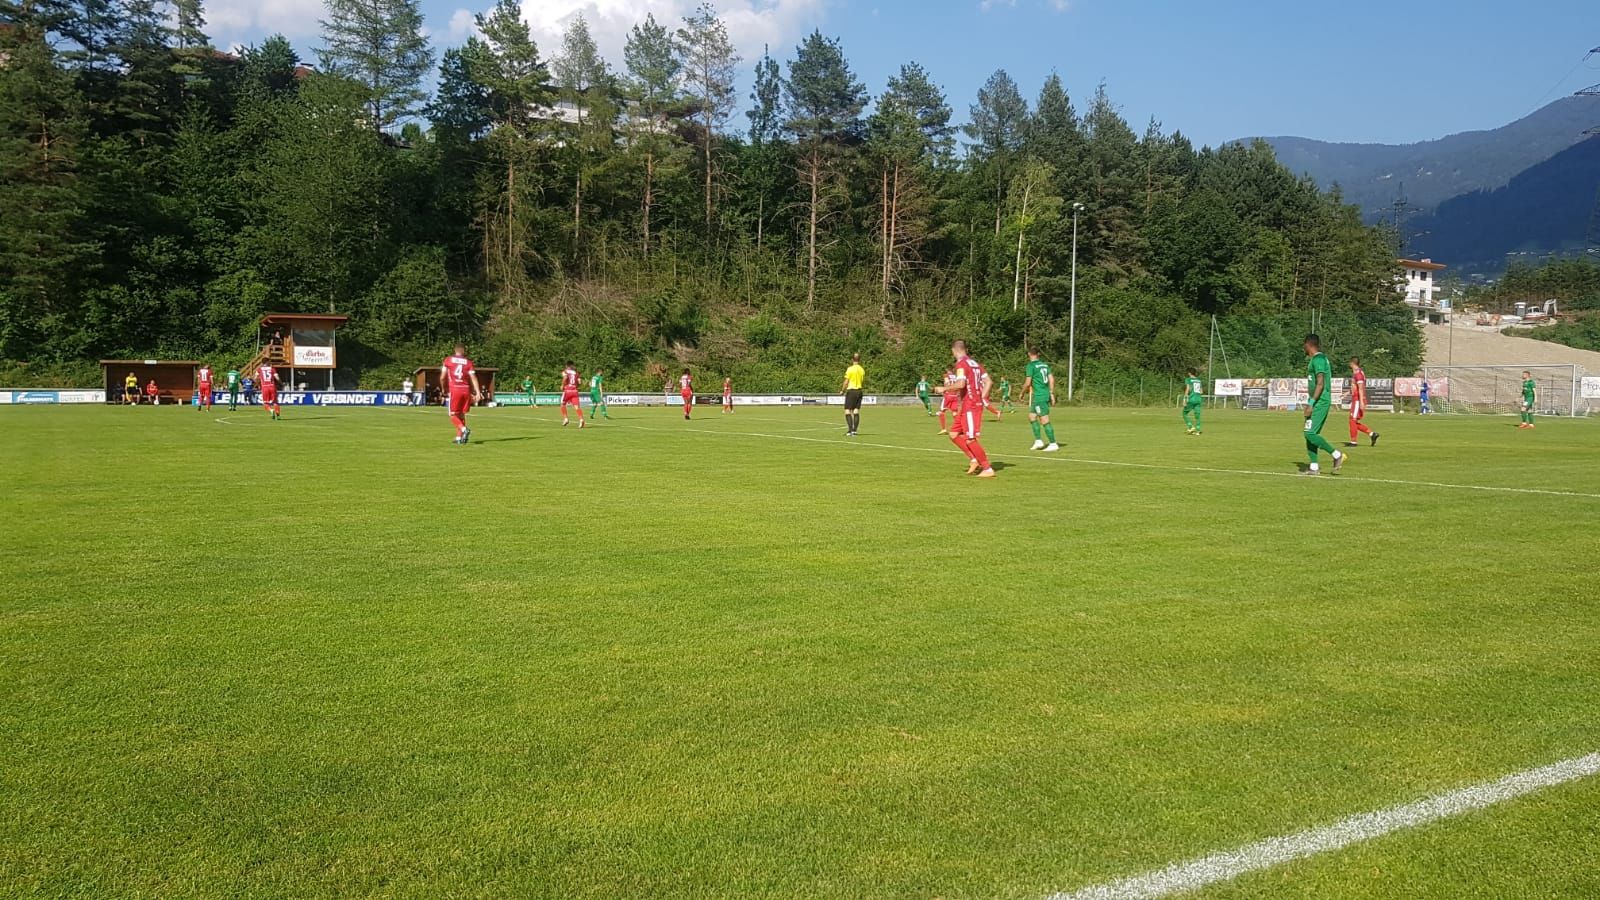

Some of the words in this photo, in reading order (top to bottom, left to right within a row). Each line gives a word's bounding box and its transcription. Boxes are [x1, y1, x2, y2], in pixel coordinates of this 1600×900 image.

[262, 370, 272, 382] 15
[454, 364, 464, 379] 4
[313, 393, 377, 405] VERBINDET
[383, 394, 408, 405] UNS
[608, 396, 631, 404] Picker
